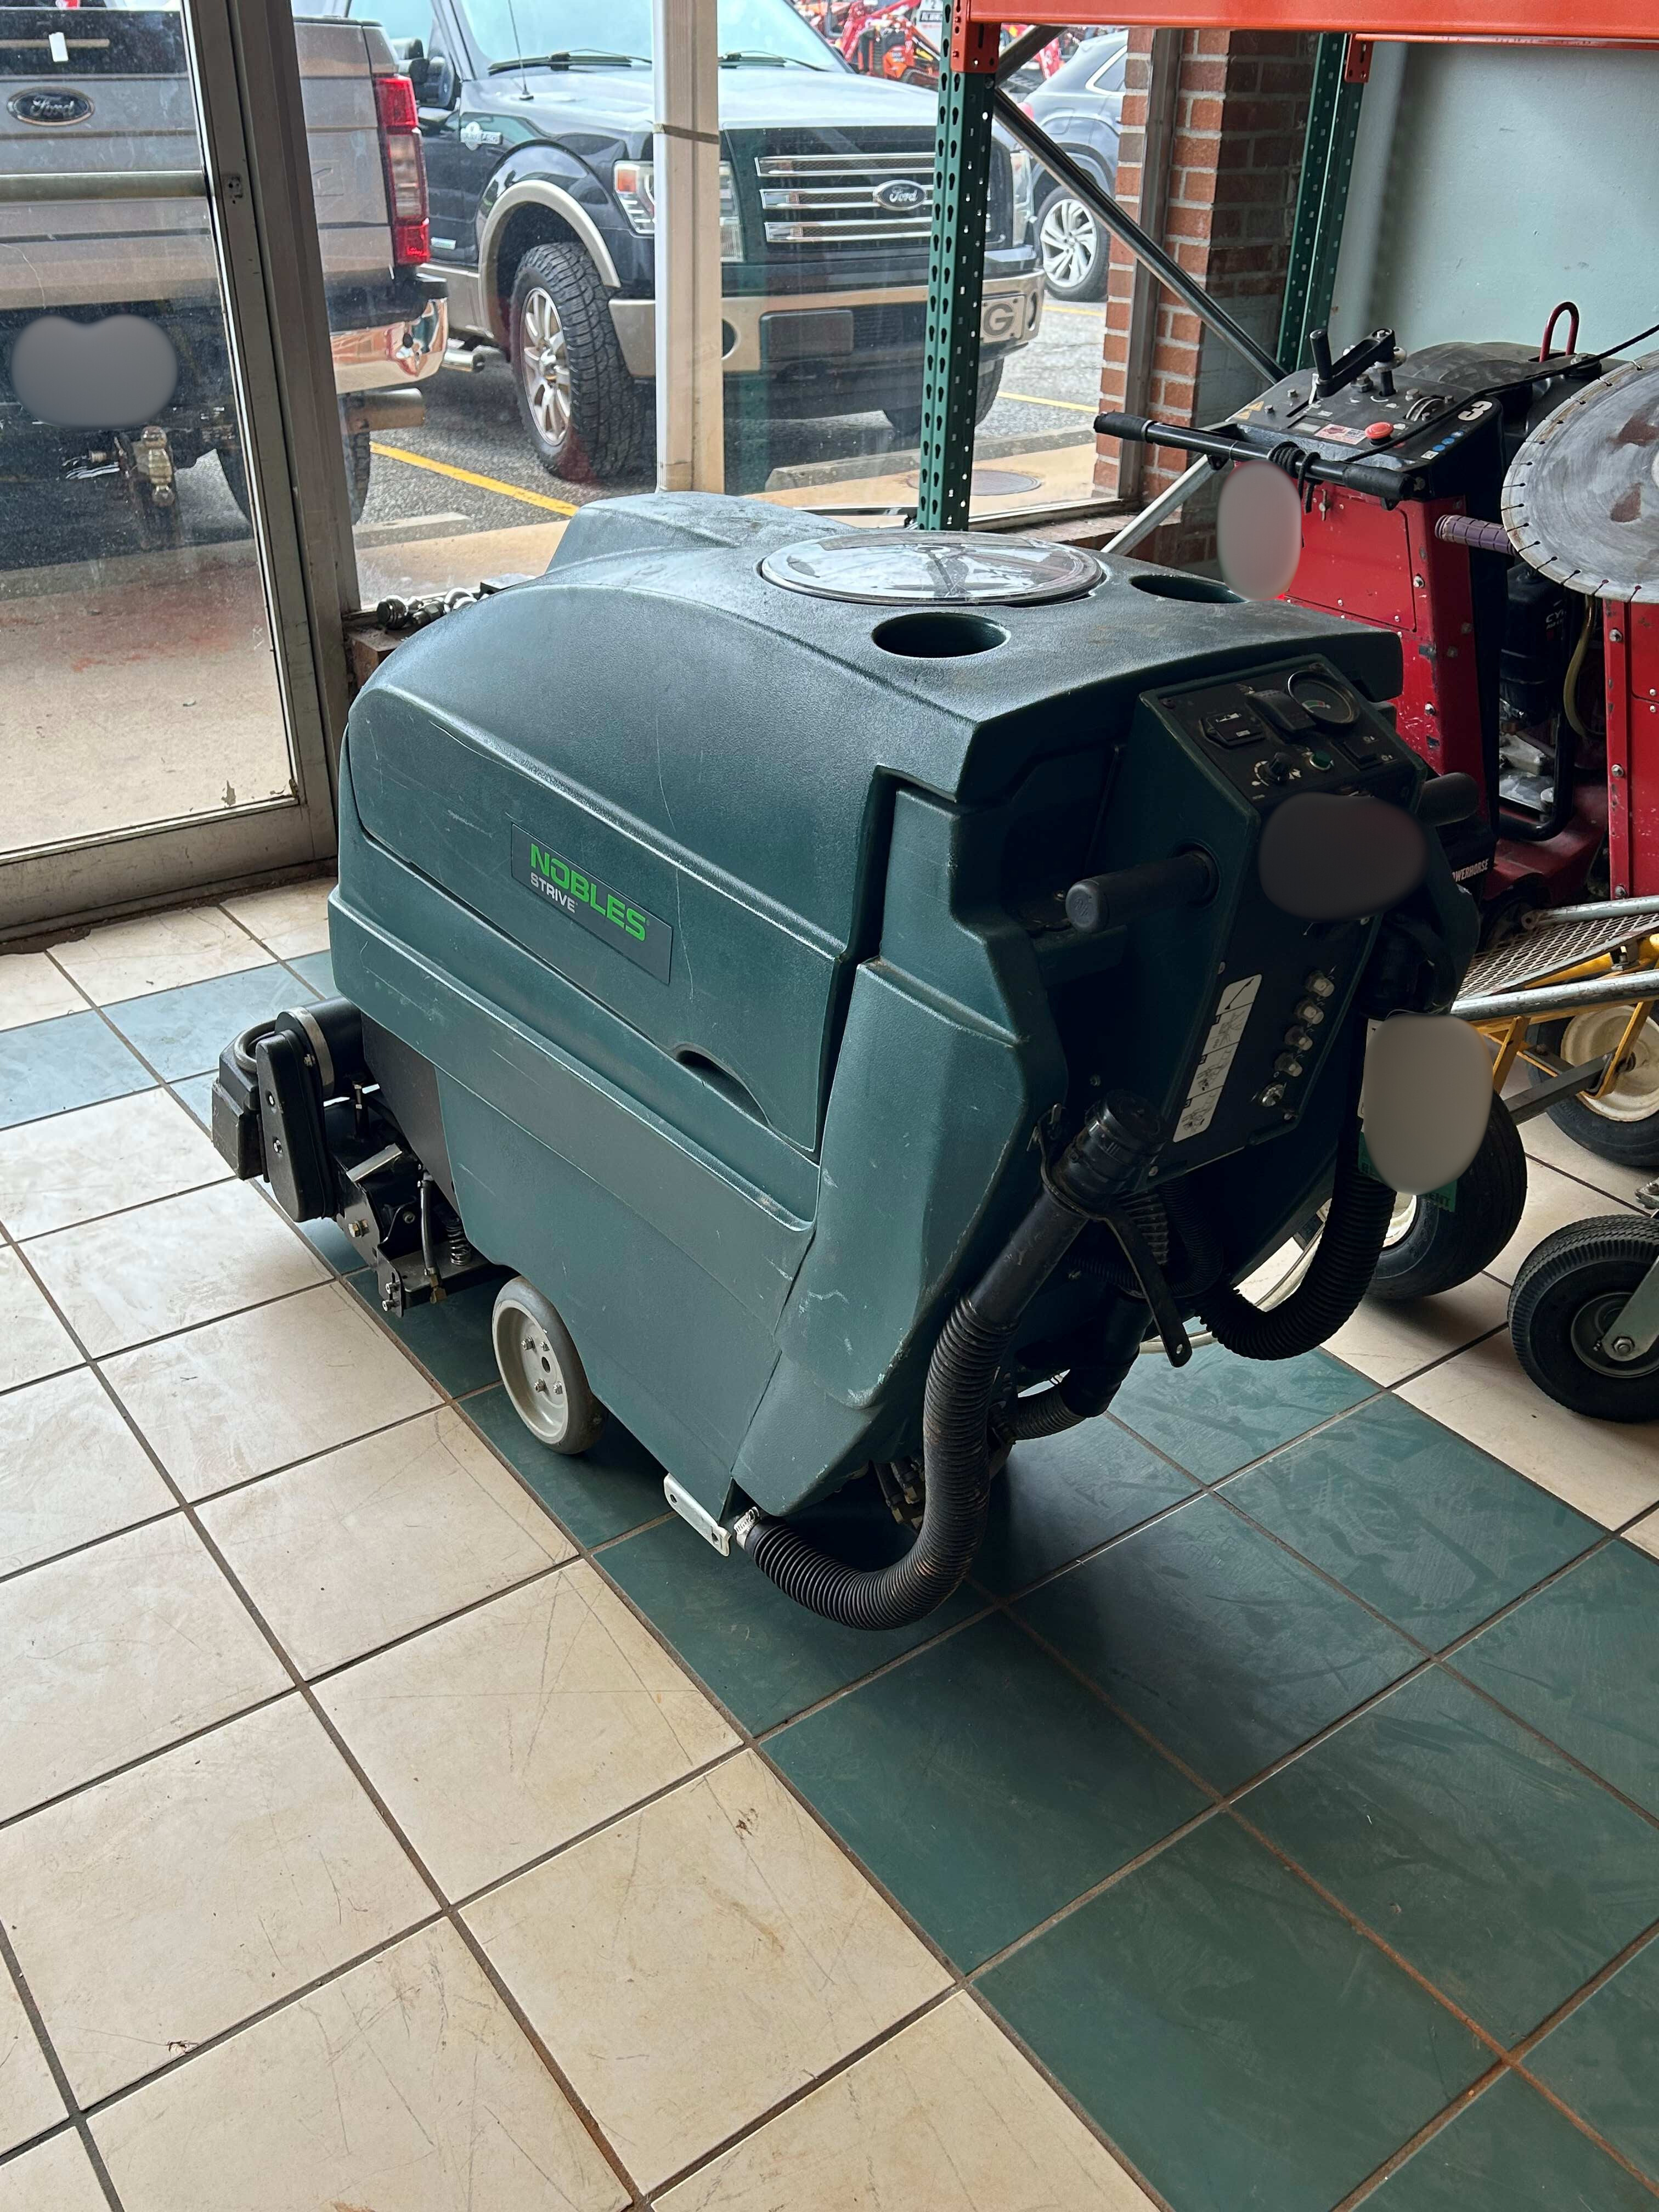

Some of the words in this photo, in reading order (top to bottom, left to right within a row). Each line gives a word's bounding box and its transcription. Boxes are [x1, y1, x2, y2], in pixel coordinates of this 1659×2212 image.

[30, 95, 75, 116] Ford
[889, 186, 918, 202] Ford
[983, 303, 1014, 336] G
[1458, 401, 1493, 421] 3
[1452, 859, 1489, 882] OWERHORSE
[530, 843, 646, 941] NOBLES
[530, 872, 575, 913] STRIVE
